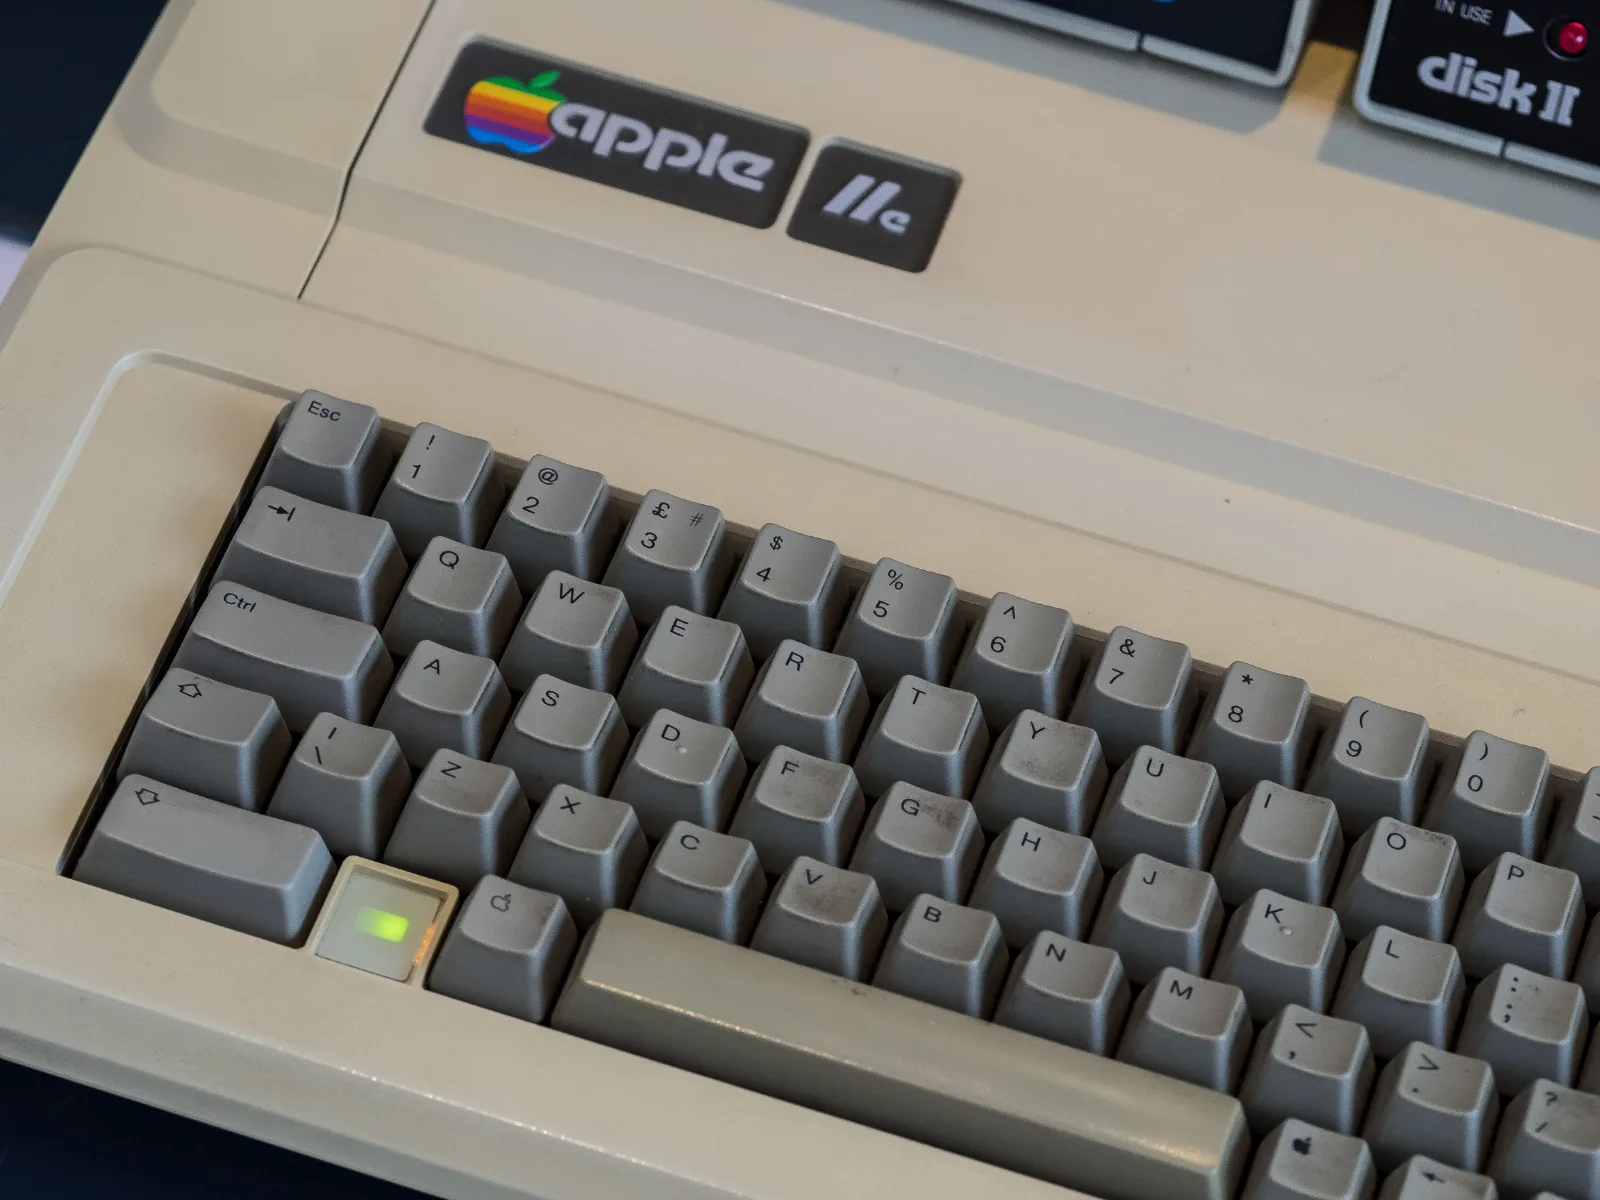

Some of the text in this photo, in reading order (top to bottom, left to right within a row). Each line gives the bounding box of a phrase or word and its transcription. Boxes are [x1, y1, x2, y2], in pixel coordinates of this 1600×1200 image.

[1460, 2, 1493, 26] USE
[1417, 52, 1537, 115] disk
[550, 102, 775, 192] apple
[307, 400, 341, 421] Esc
[426, 434, 435, 450] !
[412, 464, 421, 479] 1
[538, 467, 558, 485] @
[522, 496, 540, 514] 2
[652, 502, 703, 526] £ #
[641, 532, 658, 549] 3
[769, 536, 783, 550] $
[439, 550, 459, 569] Q
[756, 567, 772, 582] 4
[888, 569, 903, 590] %
[223, 592, 256, 613] Ctrl
[559, 583, 585, 604] W
[873, 600, 890, 618] 5
[669, 618, 689, 637] E
[990, 636, 1006, 653] 6
[1119, 639, 1135, 658] &
[423, 659, 441, 675] A
[785, 652, 804, 671] R
[1109, 668, 1124, 684] 7
[541, 690, 560, 707] S
[911, 687, 926, 705] T
[1228, 705, 1244, 723] 8
[1359, 710, 1369, 729] (
[660, 724, 681, 742] D
[1029, 721, 1046, 739] Y
[1346, 740, 1362, 757] 9
[1479, 742, 1488, 760] )
[440, 761, 462, 778] Z
[780, 761, 799, 775] F
[1146, 759, 1164, 777] U
[1468, 775, 1483, 792] 0
[560, 796, 581, 815] X
[901, 798, 920, 816] G
[680, 834, 700, 850] C
[1021, 832, 1041, 851] H
[1387, 833, 1406, 850] O
[805, 869, 823, 885] V
[1143, 871, 1157, 885] J
[1507, 865, 1524, 880] P
[923, 906, 942, 922] B
[1264, 904, 1283, 924] K
[1046, 944, 1066, 962] N
[1386, 939, 1399, 959] L
[1170, 980, 1193, 1000] M
